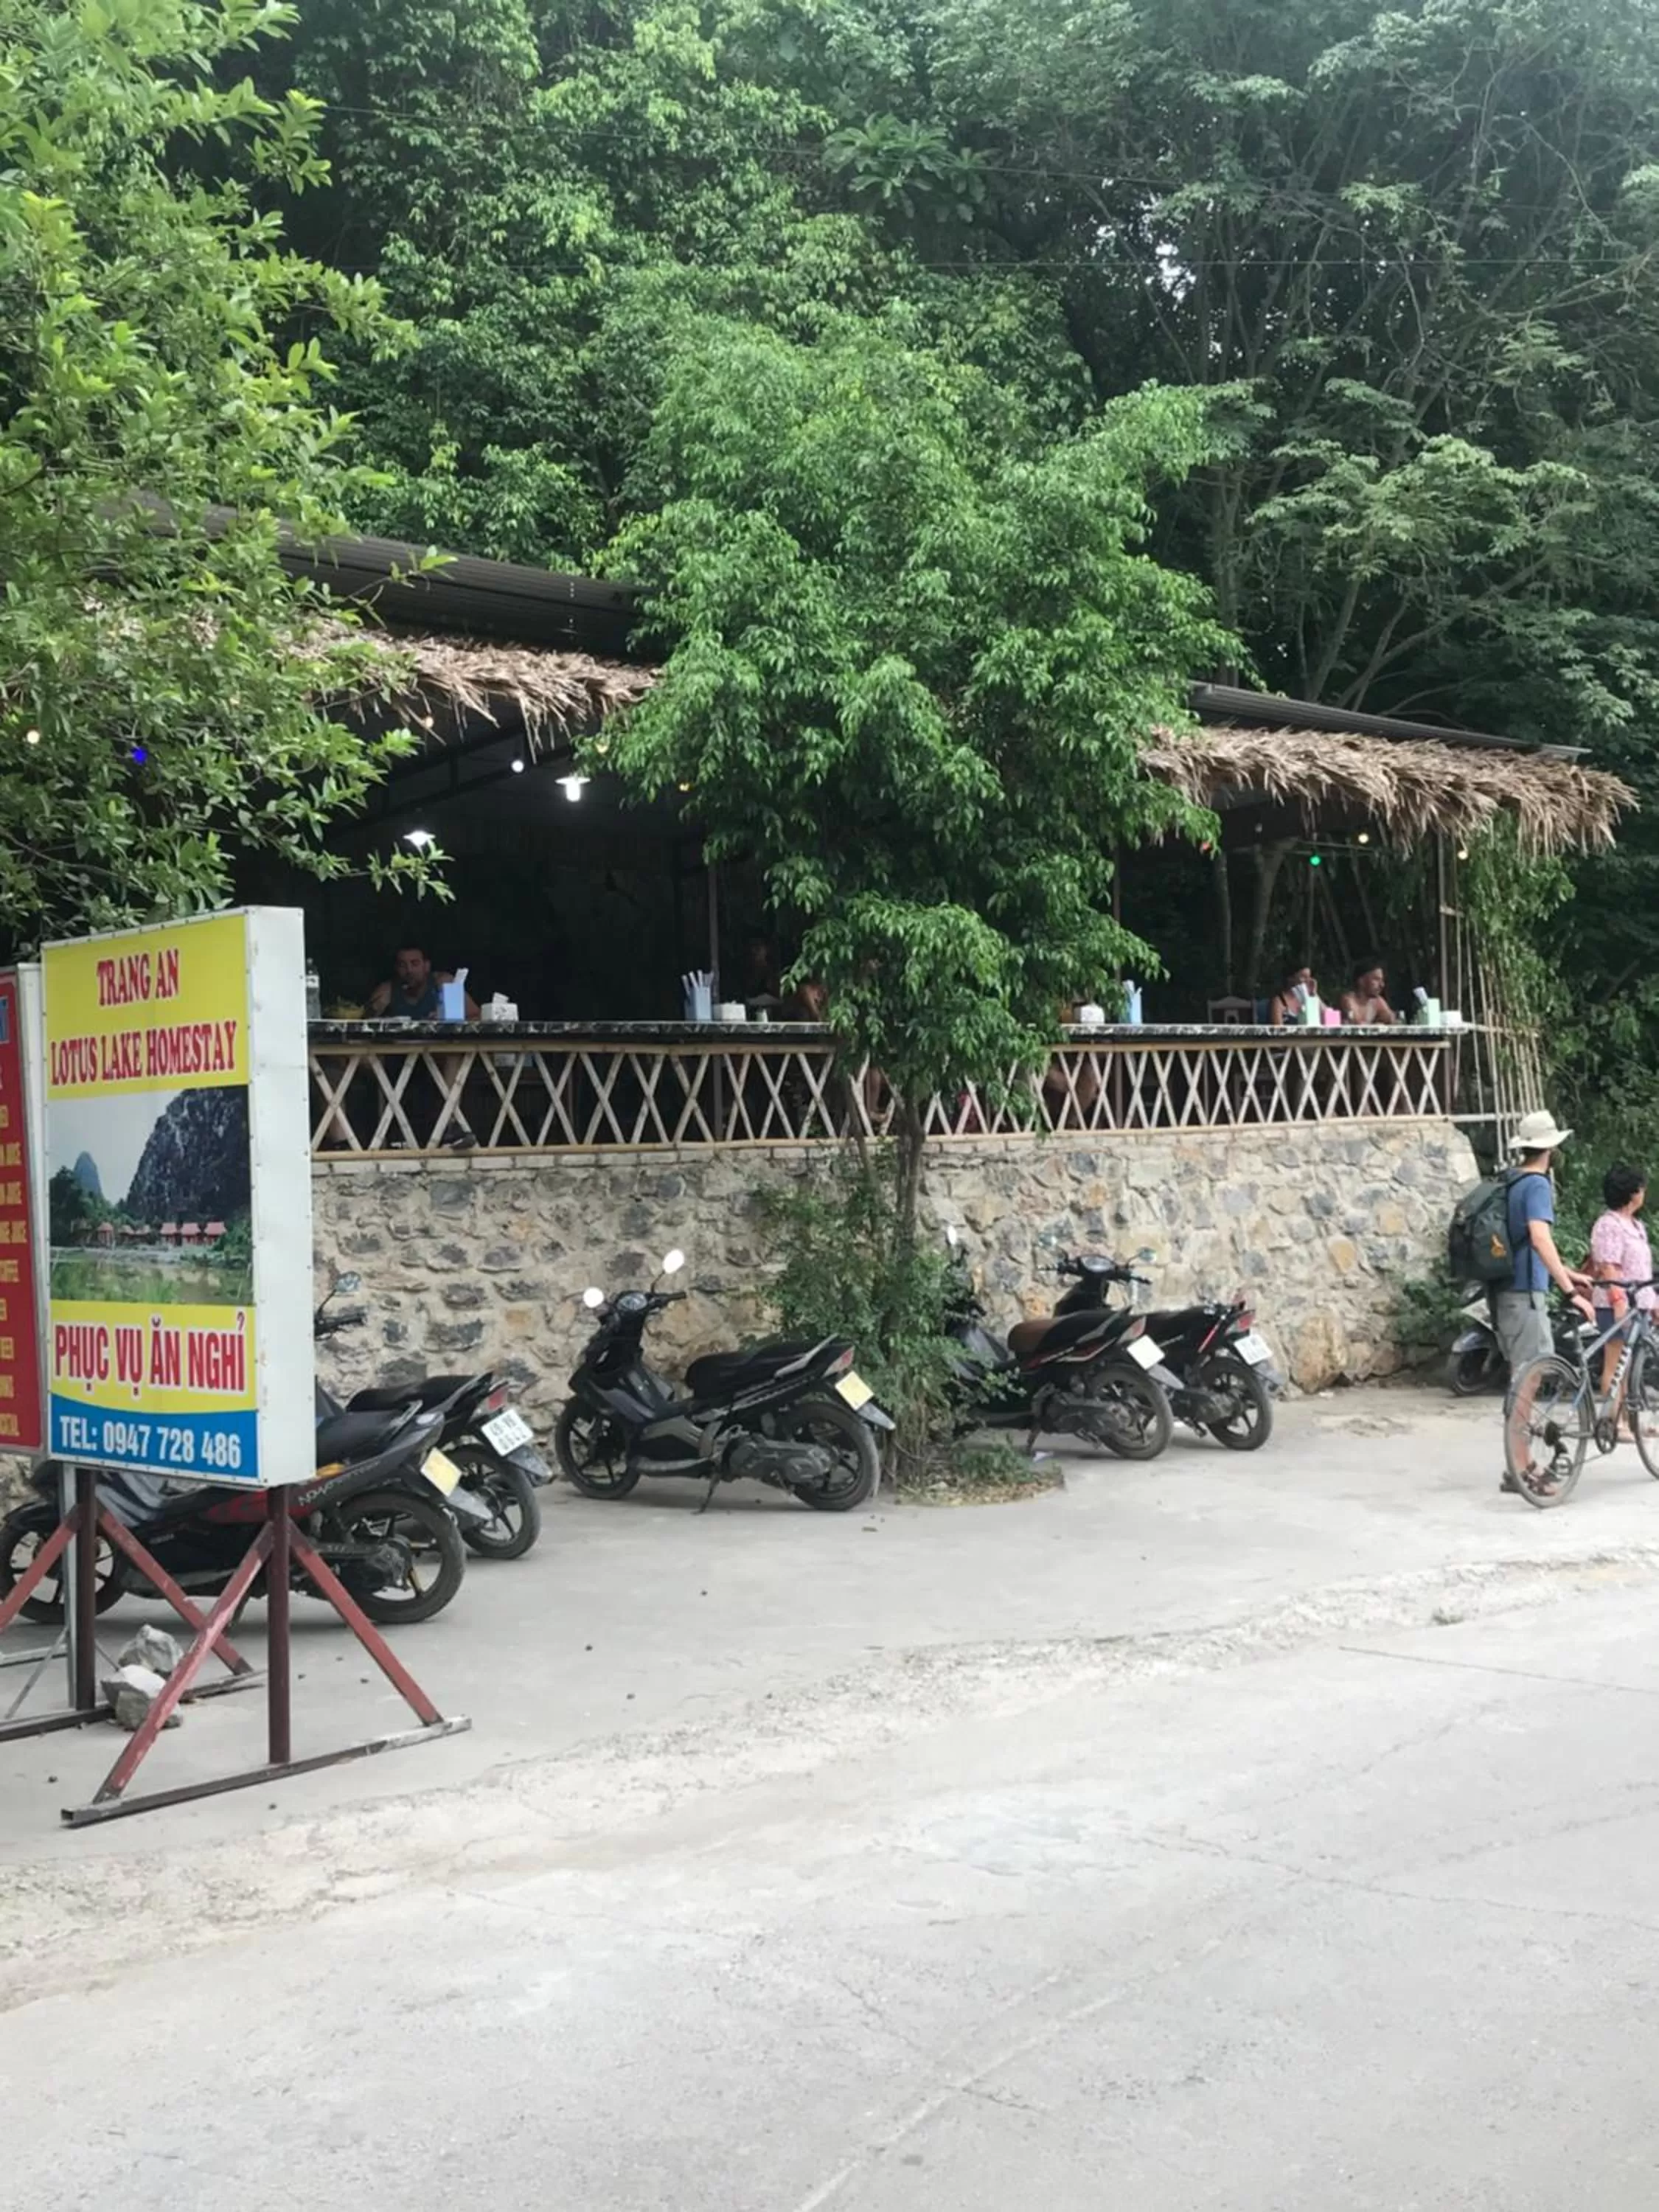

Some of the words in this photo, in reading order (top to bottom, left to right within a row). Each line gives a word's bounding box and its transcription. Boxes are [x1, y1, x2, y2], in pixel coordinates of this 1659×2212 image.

[97, 952, 151, 1006] TRANG
[156, 947, 180, 999] AN
[50, 1037, 97, 1086] LOTUS
[100, 1031, 143, 1081] LAKE
[147, 1020, 237, 1077] HOMESTAY
[55, 1324, 109, 1391] PHỤC
[115, 1326, 143, 1396] VỤ
[150, 1315, 181, 1387] ĂN
[188, 1311, 246, 1391] NGHỈ
[59, 1415, 97, 1450] TEL:
[102, 1420, 151, 1458] 0947
[157, 1426, 195, 1464] 728
[201, 1431, 242, 1470] 486
